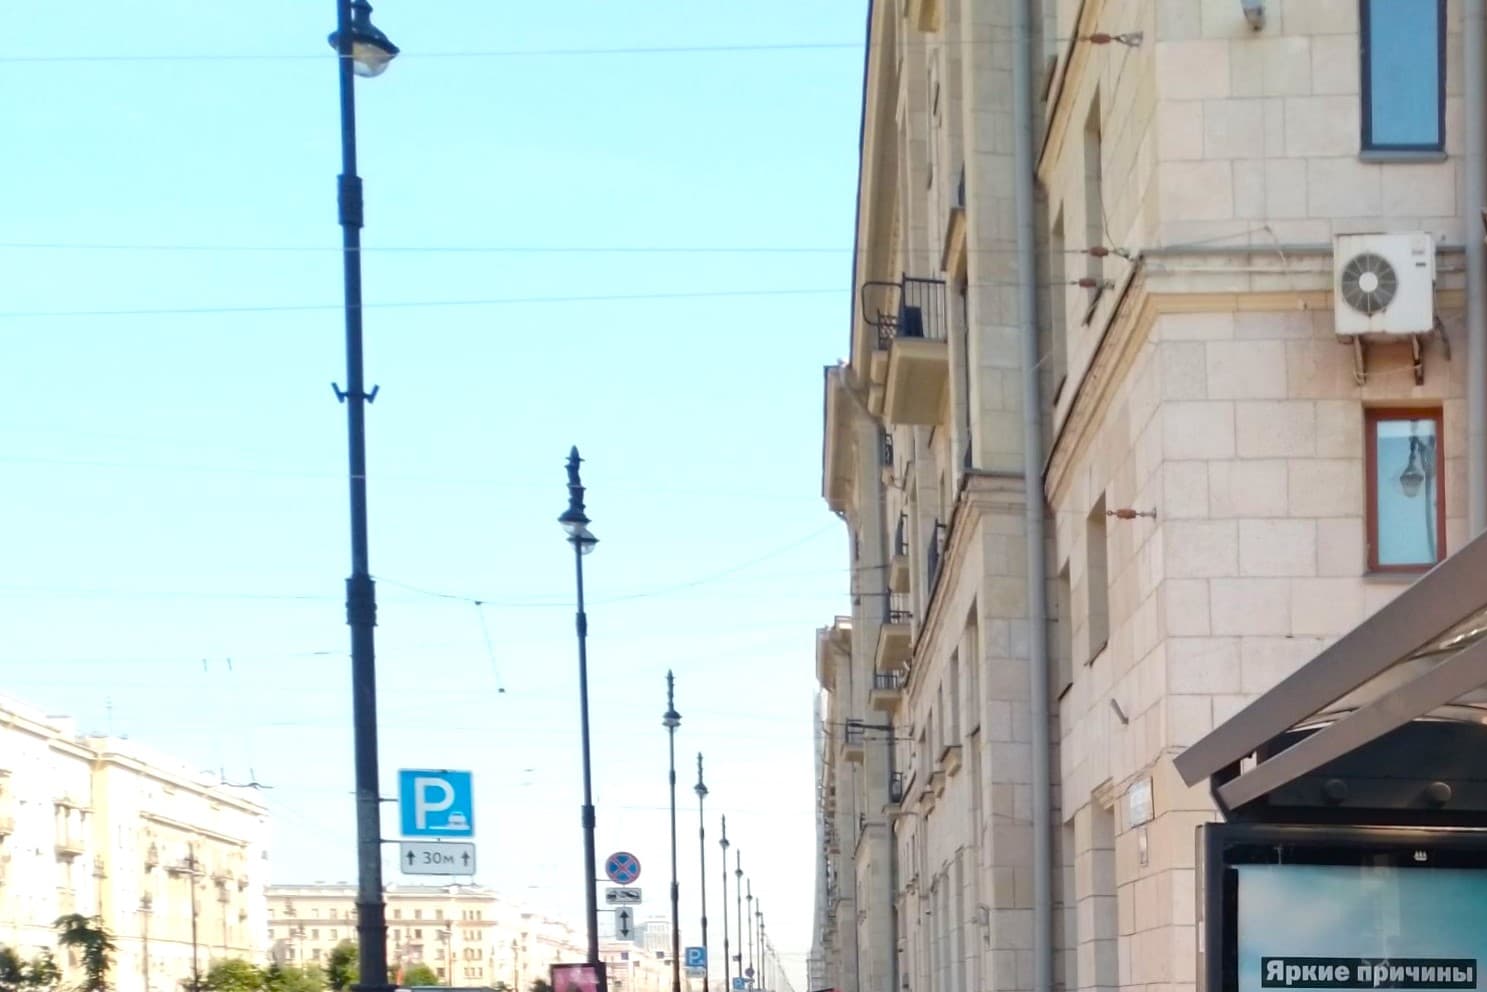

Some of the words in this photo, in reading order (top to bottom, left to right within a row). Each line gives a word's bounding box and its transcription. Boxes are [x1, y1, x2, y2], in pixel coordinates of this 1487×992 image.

[414, 777, 455, 829] P
[1266, 960, 1350, 985] Яркие
[1357, 965, 1473, 987] причины
